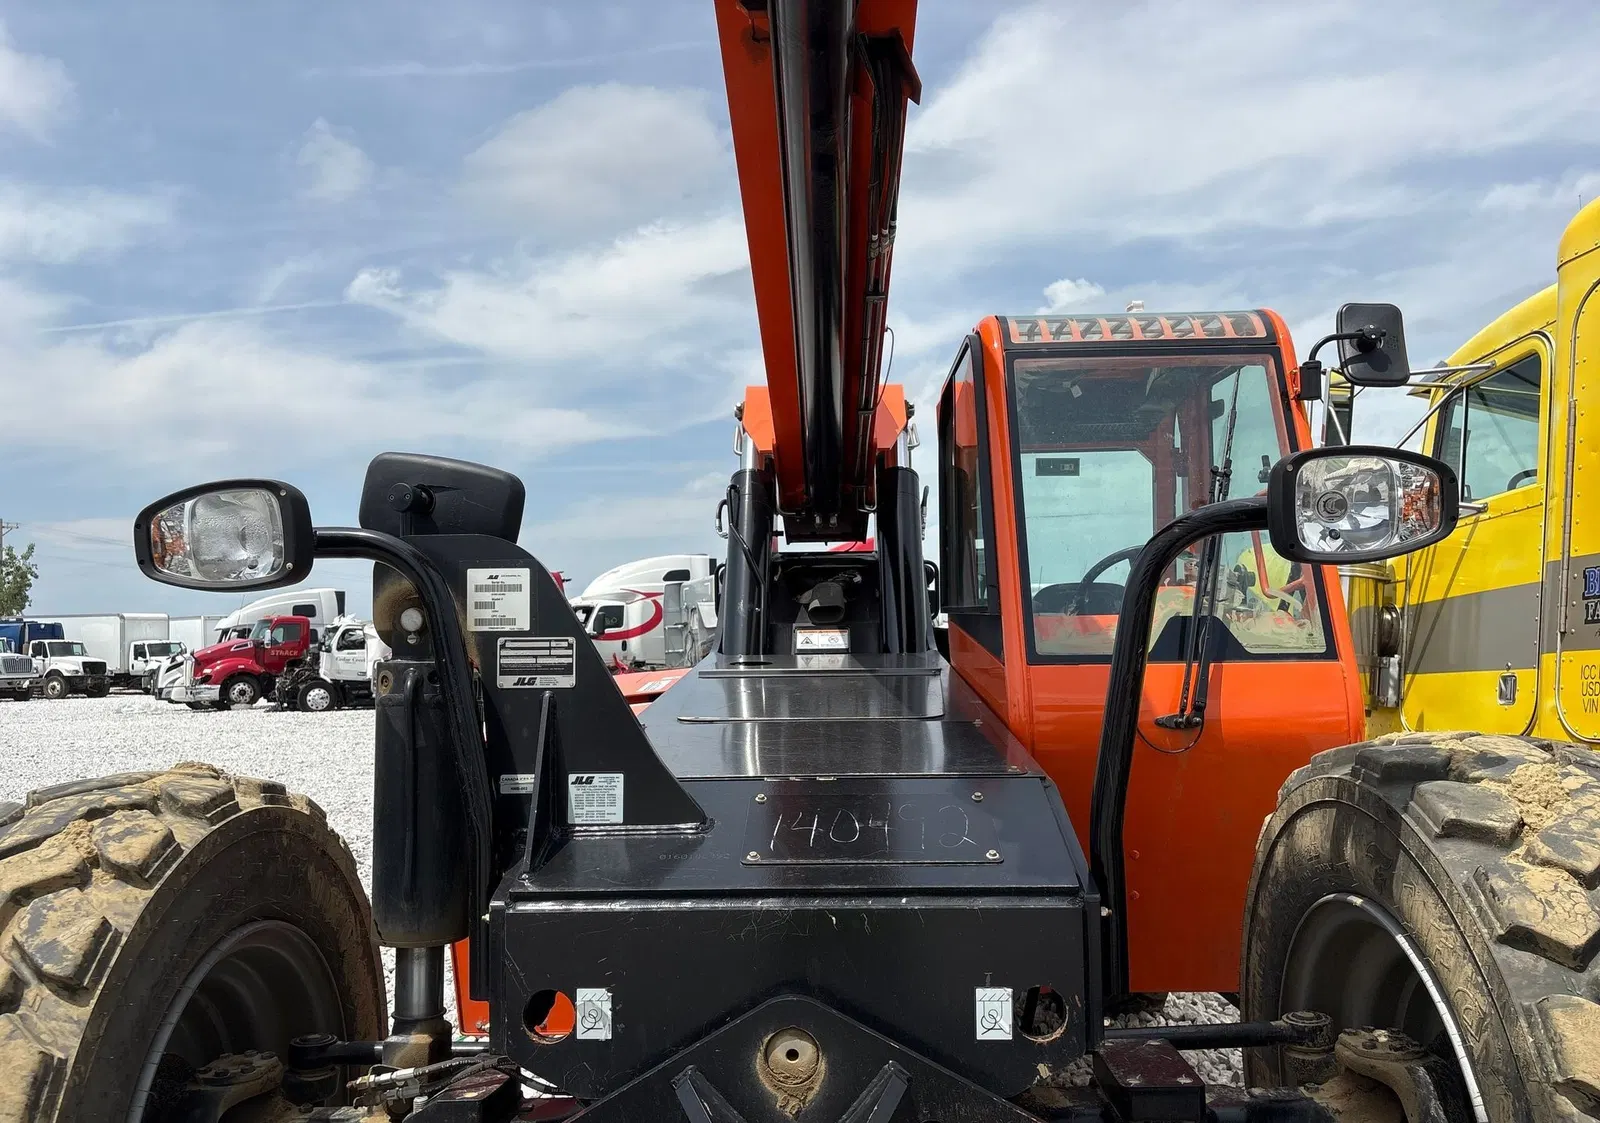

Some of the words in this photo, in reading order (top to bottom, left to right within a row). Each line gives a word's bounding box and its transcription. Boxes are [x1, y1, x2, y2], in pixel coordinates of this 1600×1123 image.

[1580, 664, 1597, 680] ICC
[513, 677, 538, 686] JLG
[1583, 698, 1599, 713] VIN
[571, 776, 595, 785] JLG
[770, 802, 979, 851] 140492
